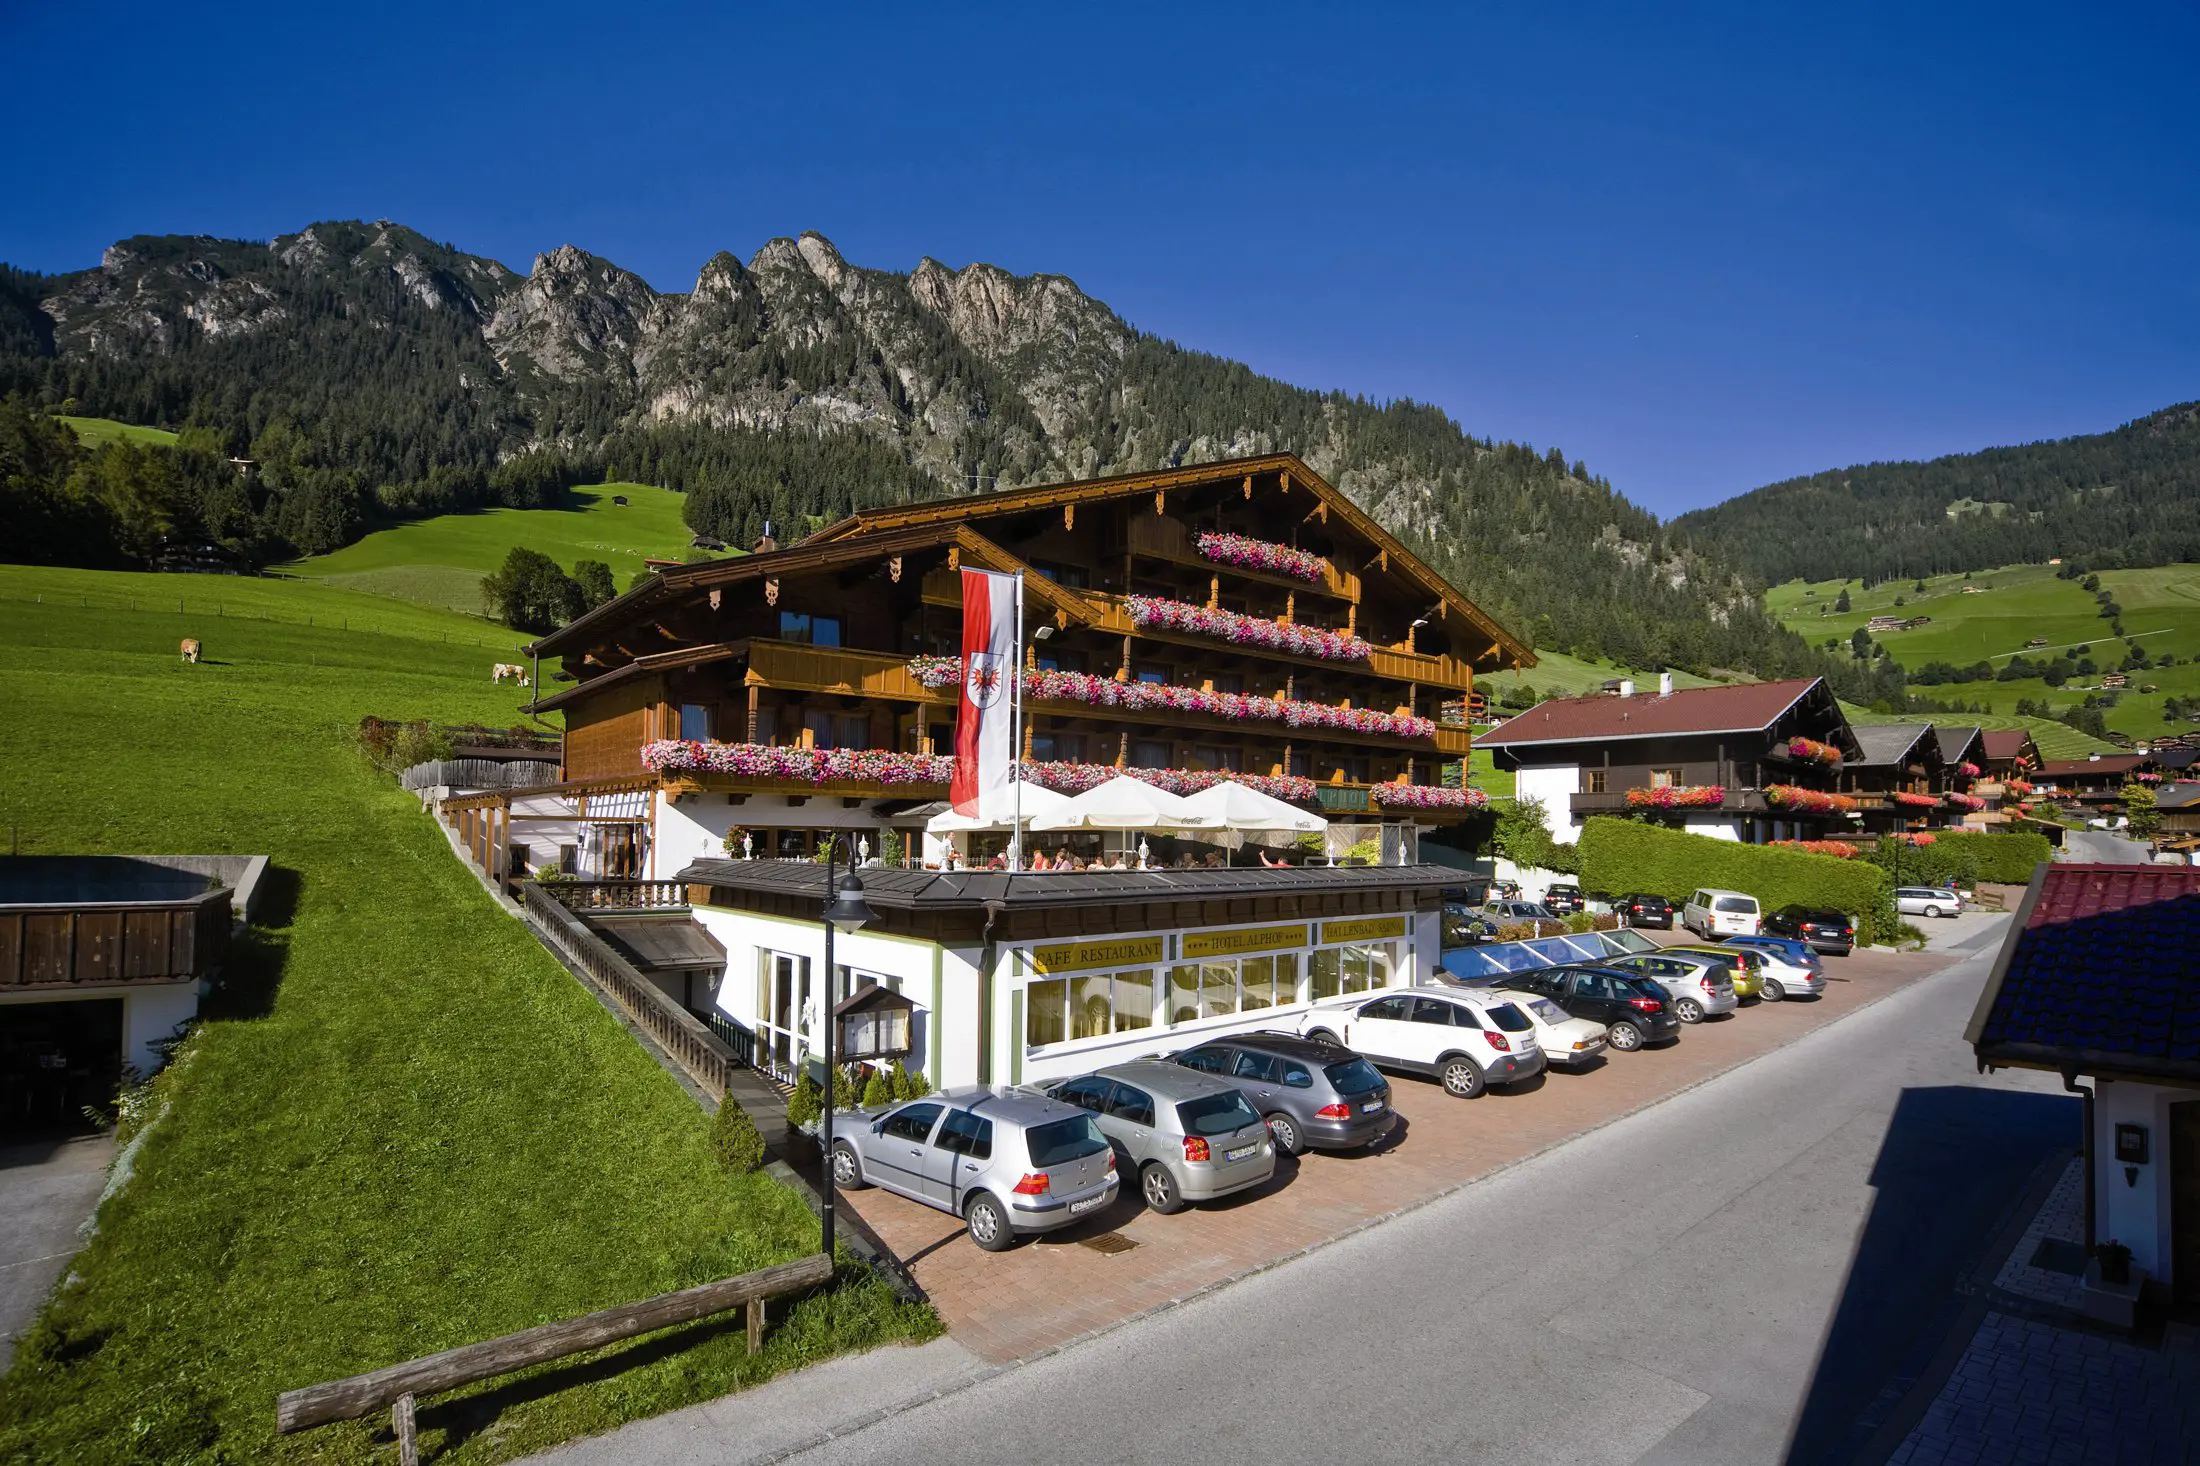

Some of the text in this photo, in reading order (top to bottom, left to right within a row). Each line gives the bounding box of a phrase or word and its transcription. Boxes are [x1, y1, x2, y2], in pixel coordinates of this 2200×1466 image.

[1211, 932, 1284, 950] HOTEL ALPHOF
[1036, 943, 1161, 967] CAFE RESTAURANT
